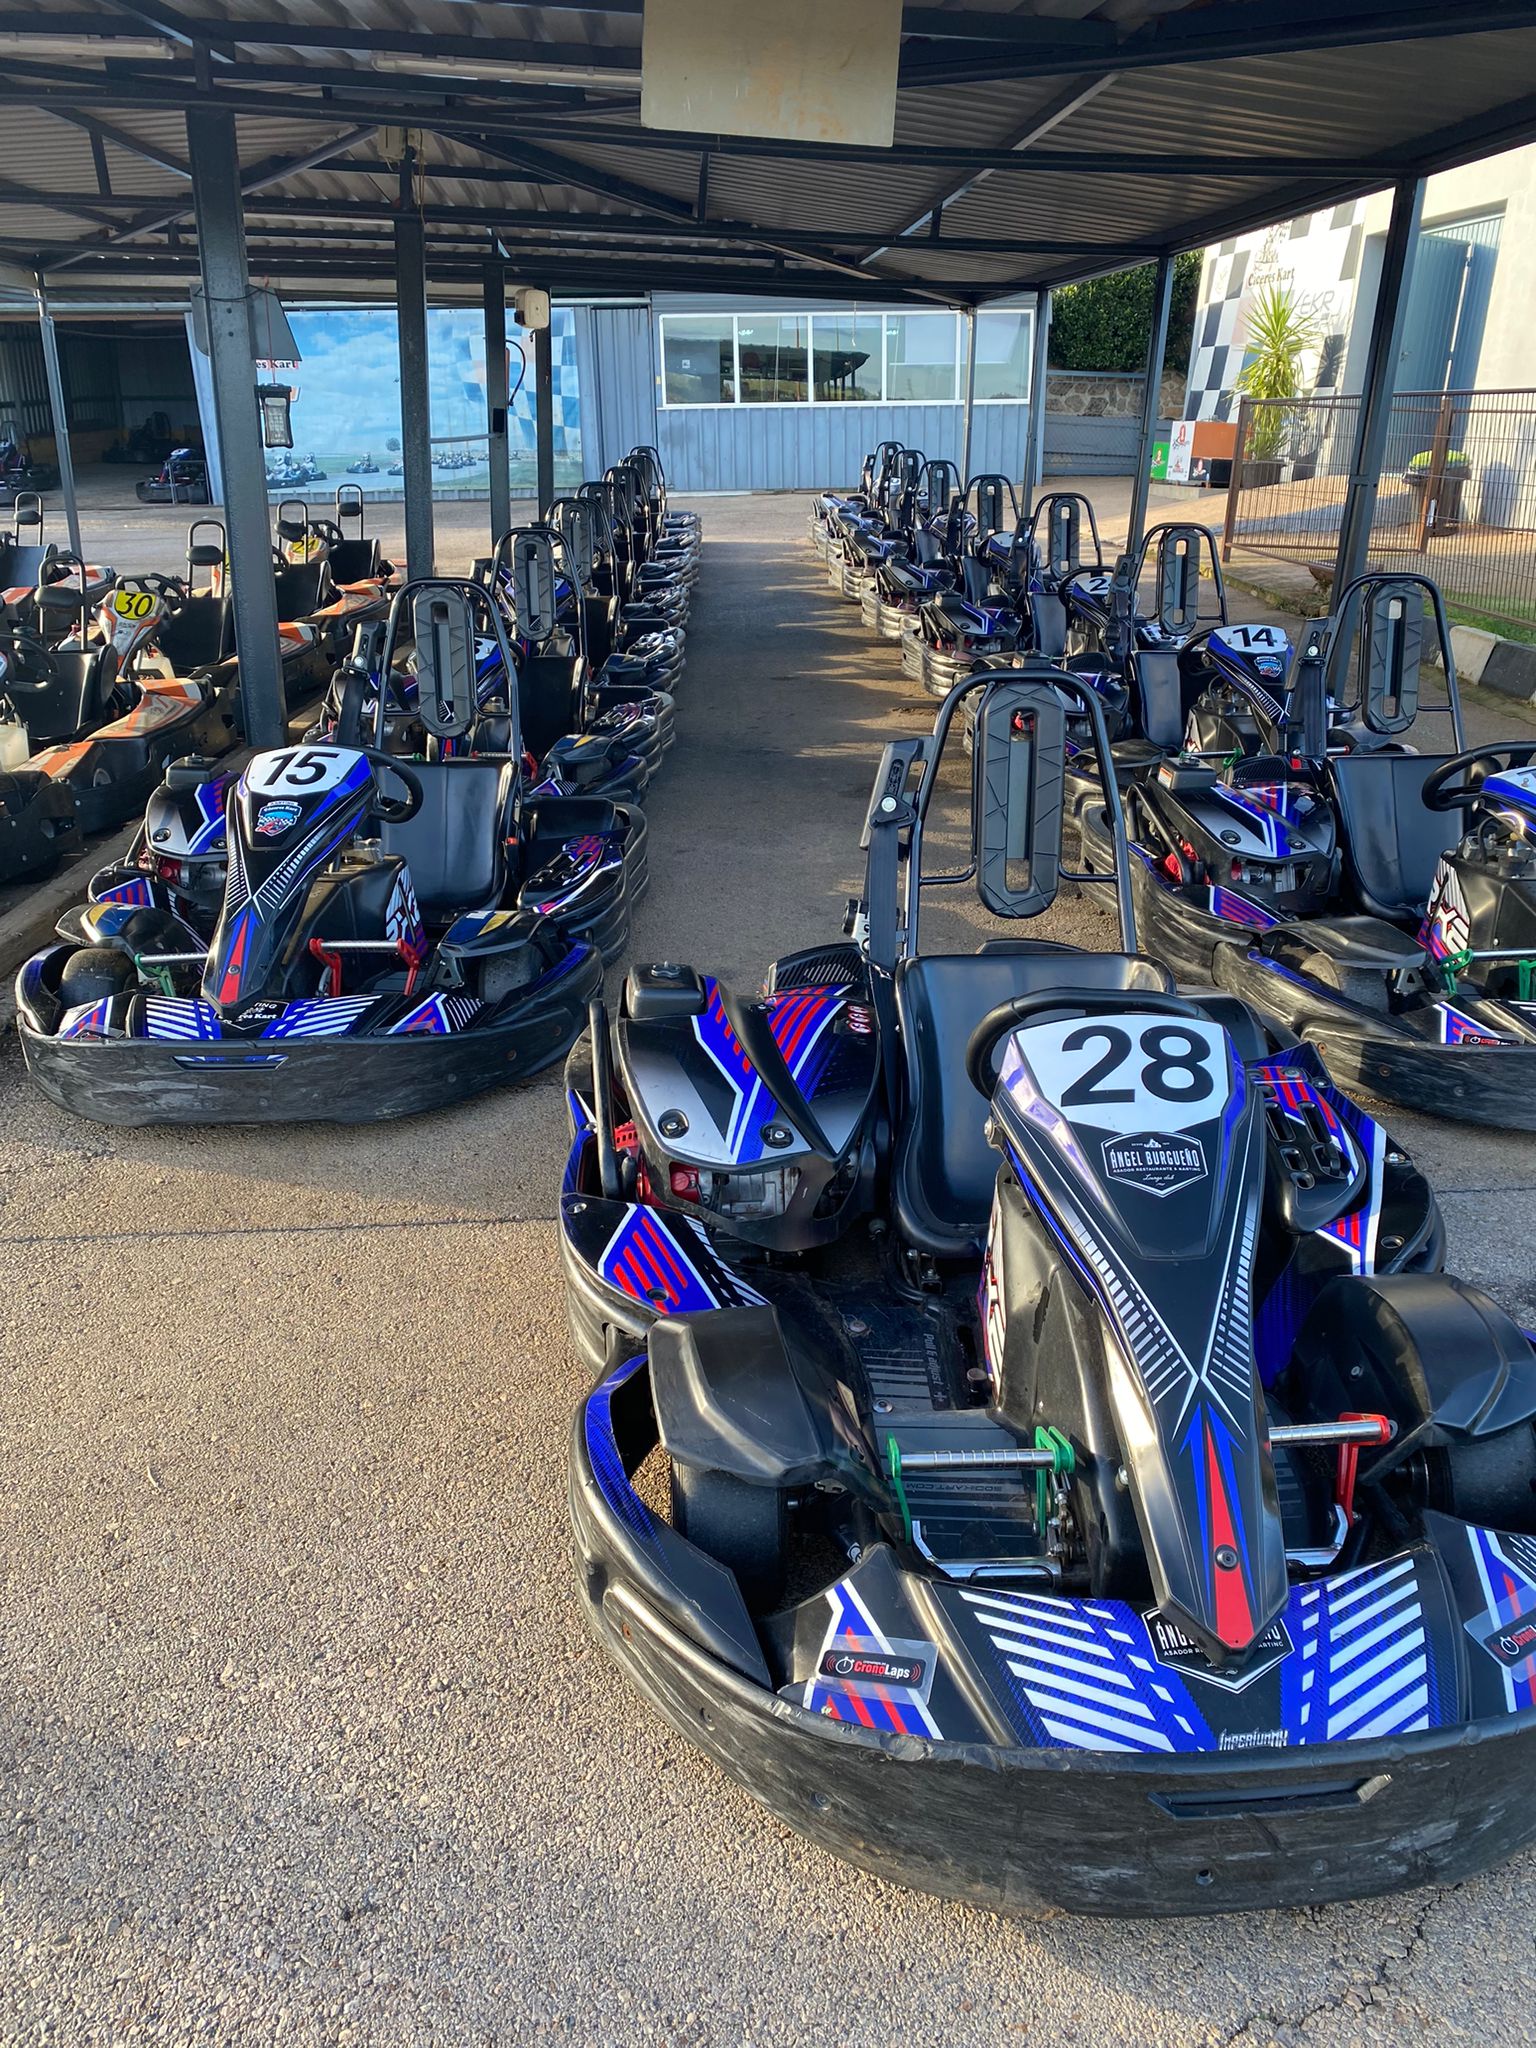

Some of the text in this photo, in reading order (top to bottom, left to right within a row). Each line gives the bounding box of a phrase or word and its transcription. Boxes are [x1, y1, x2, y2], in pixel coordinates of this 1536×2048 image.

[1277, 266, 1295, 282] Kart
[1089, 577, 1111, 592] 2
[117, 592, 153, 618] 30
[1232, 626, 1278, 648] 14
[263, 750, 341, 787] 15
[1060, 1024, 1215, 1108] 28
[1109, 1147, 1201, 1169] ÁNGEL BURGUEÑO
[1164, 1648, 1193, 1657] ASADOR
[1258, 1641, 1284, 1649] ARTING
[853, 1660, 911, 1680] CronoLaps
